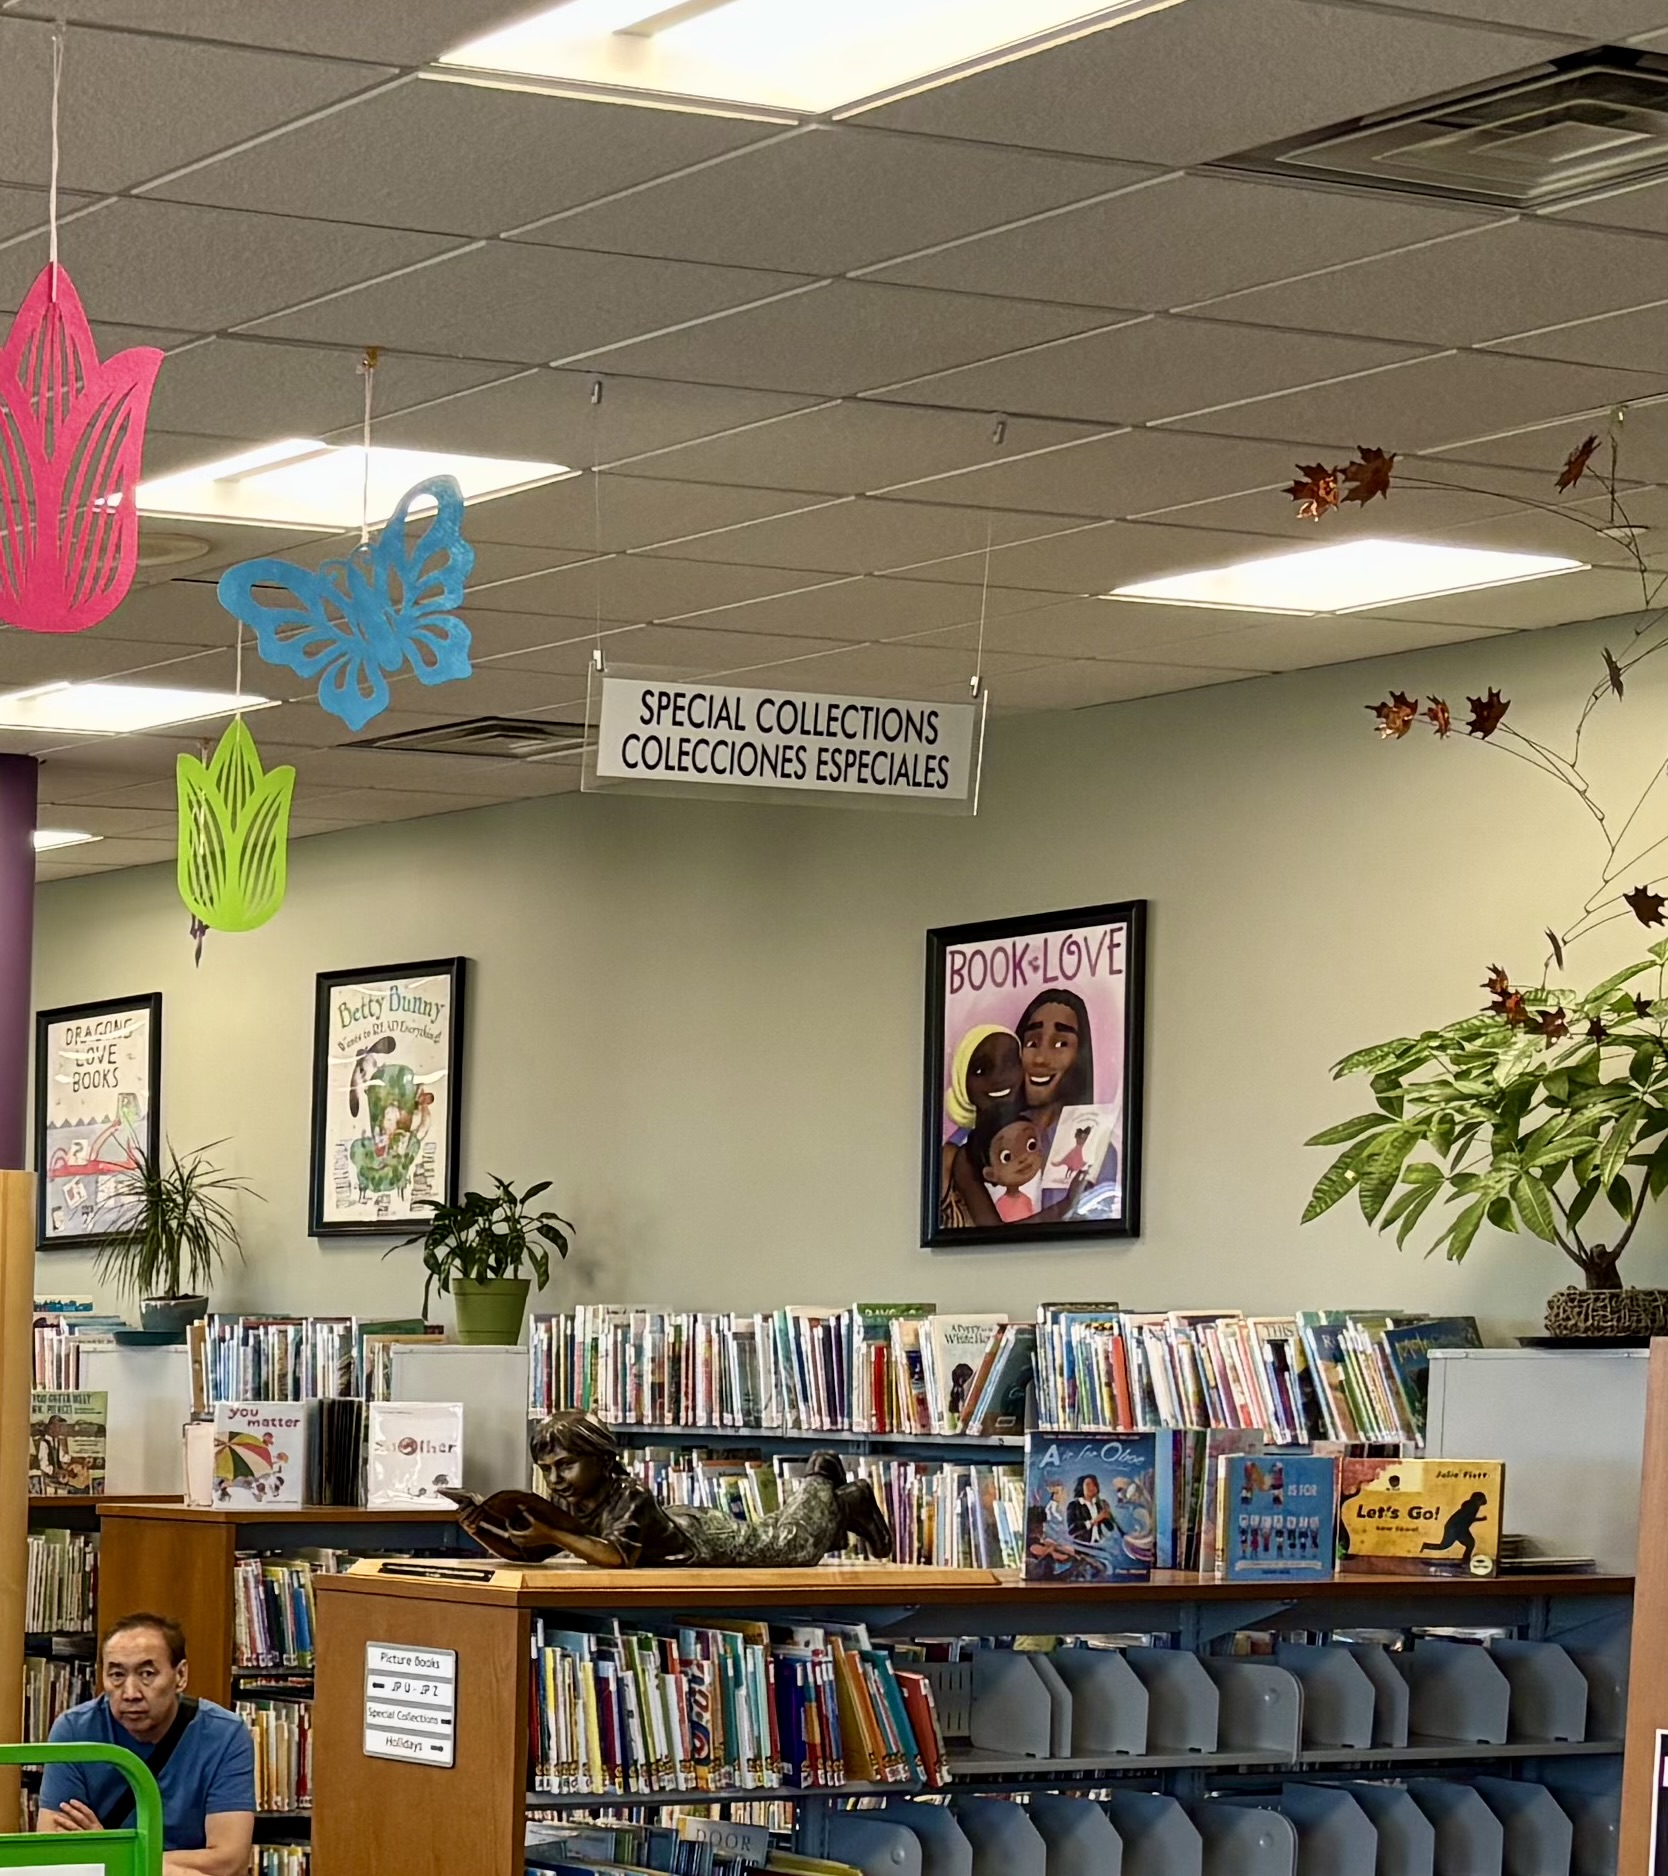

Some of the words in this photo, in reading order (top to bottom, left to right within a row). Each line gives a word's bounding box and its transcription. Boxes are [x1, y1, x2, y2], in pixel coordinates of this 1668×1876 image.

[640, 689, 746, 734] SPECIAL
[756, 698, 940, 746] COLLECTIONS
[621, 734, 808, 780] COLECCIONES
[816, 747, 950, 791] ESPECIALES
[948, 940, 1030, 995] BOOK
[1042, 926, 1124, 984] LOVE
[338, 996, 385, 1029] Betty
[389, 985, 445, 1024] Bunny
[74, 1044, 117, 1068] LOVE
[72, 1067, 120, 1093] BOOKS
[228, 1407, 259, 1419] you
[247, 1417, 301, 1428] matter
[1038, 1443, 1060, 1469] A
[1100, 1441, 1145, 1466] Oboe
[1435, 1470, 1459, 1479] Julie
[1357, 1504, 1400, 1520] Let's
[1407, 1505, 1441, 1521] Go!
[380, 1652, 412, 1666] Picture
[414, 1656, 440, 1669] Books
[368, 1707, 395, 1719] Special
[397, 1711, 438, 1725] Collections
[386, 1736, 423, 1753] Holidays
